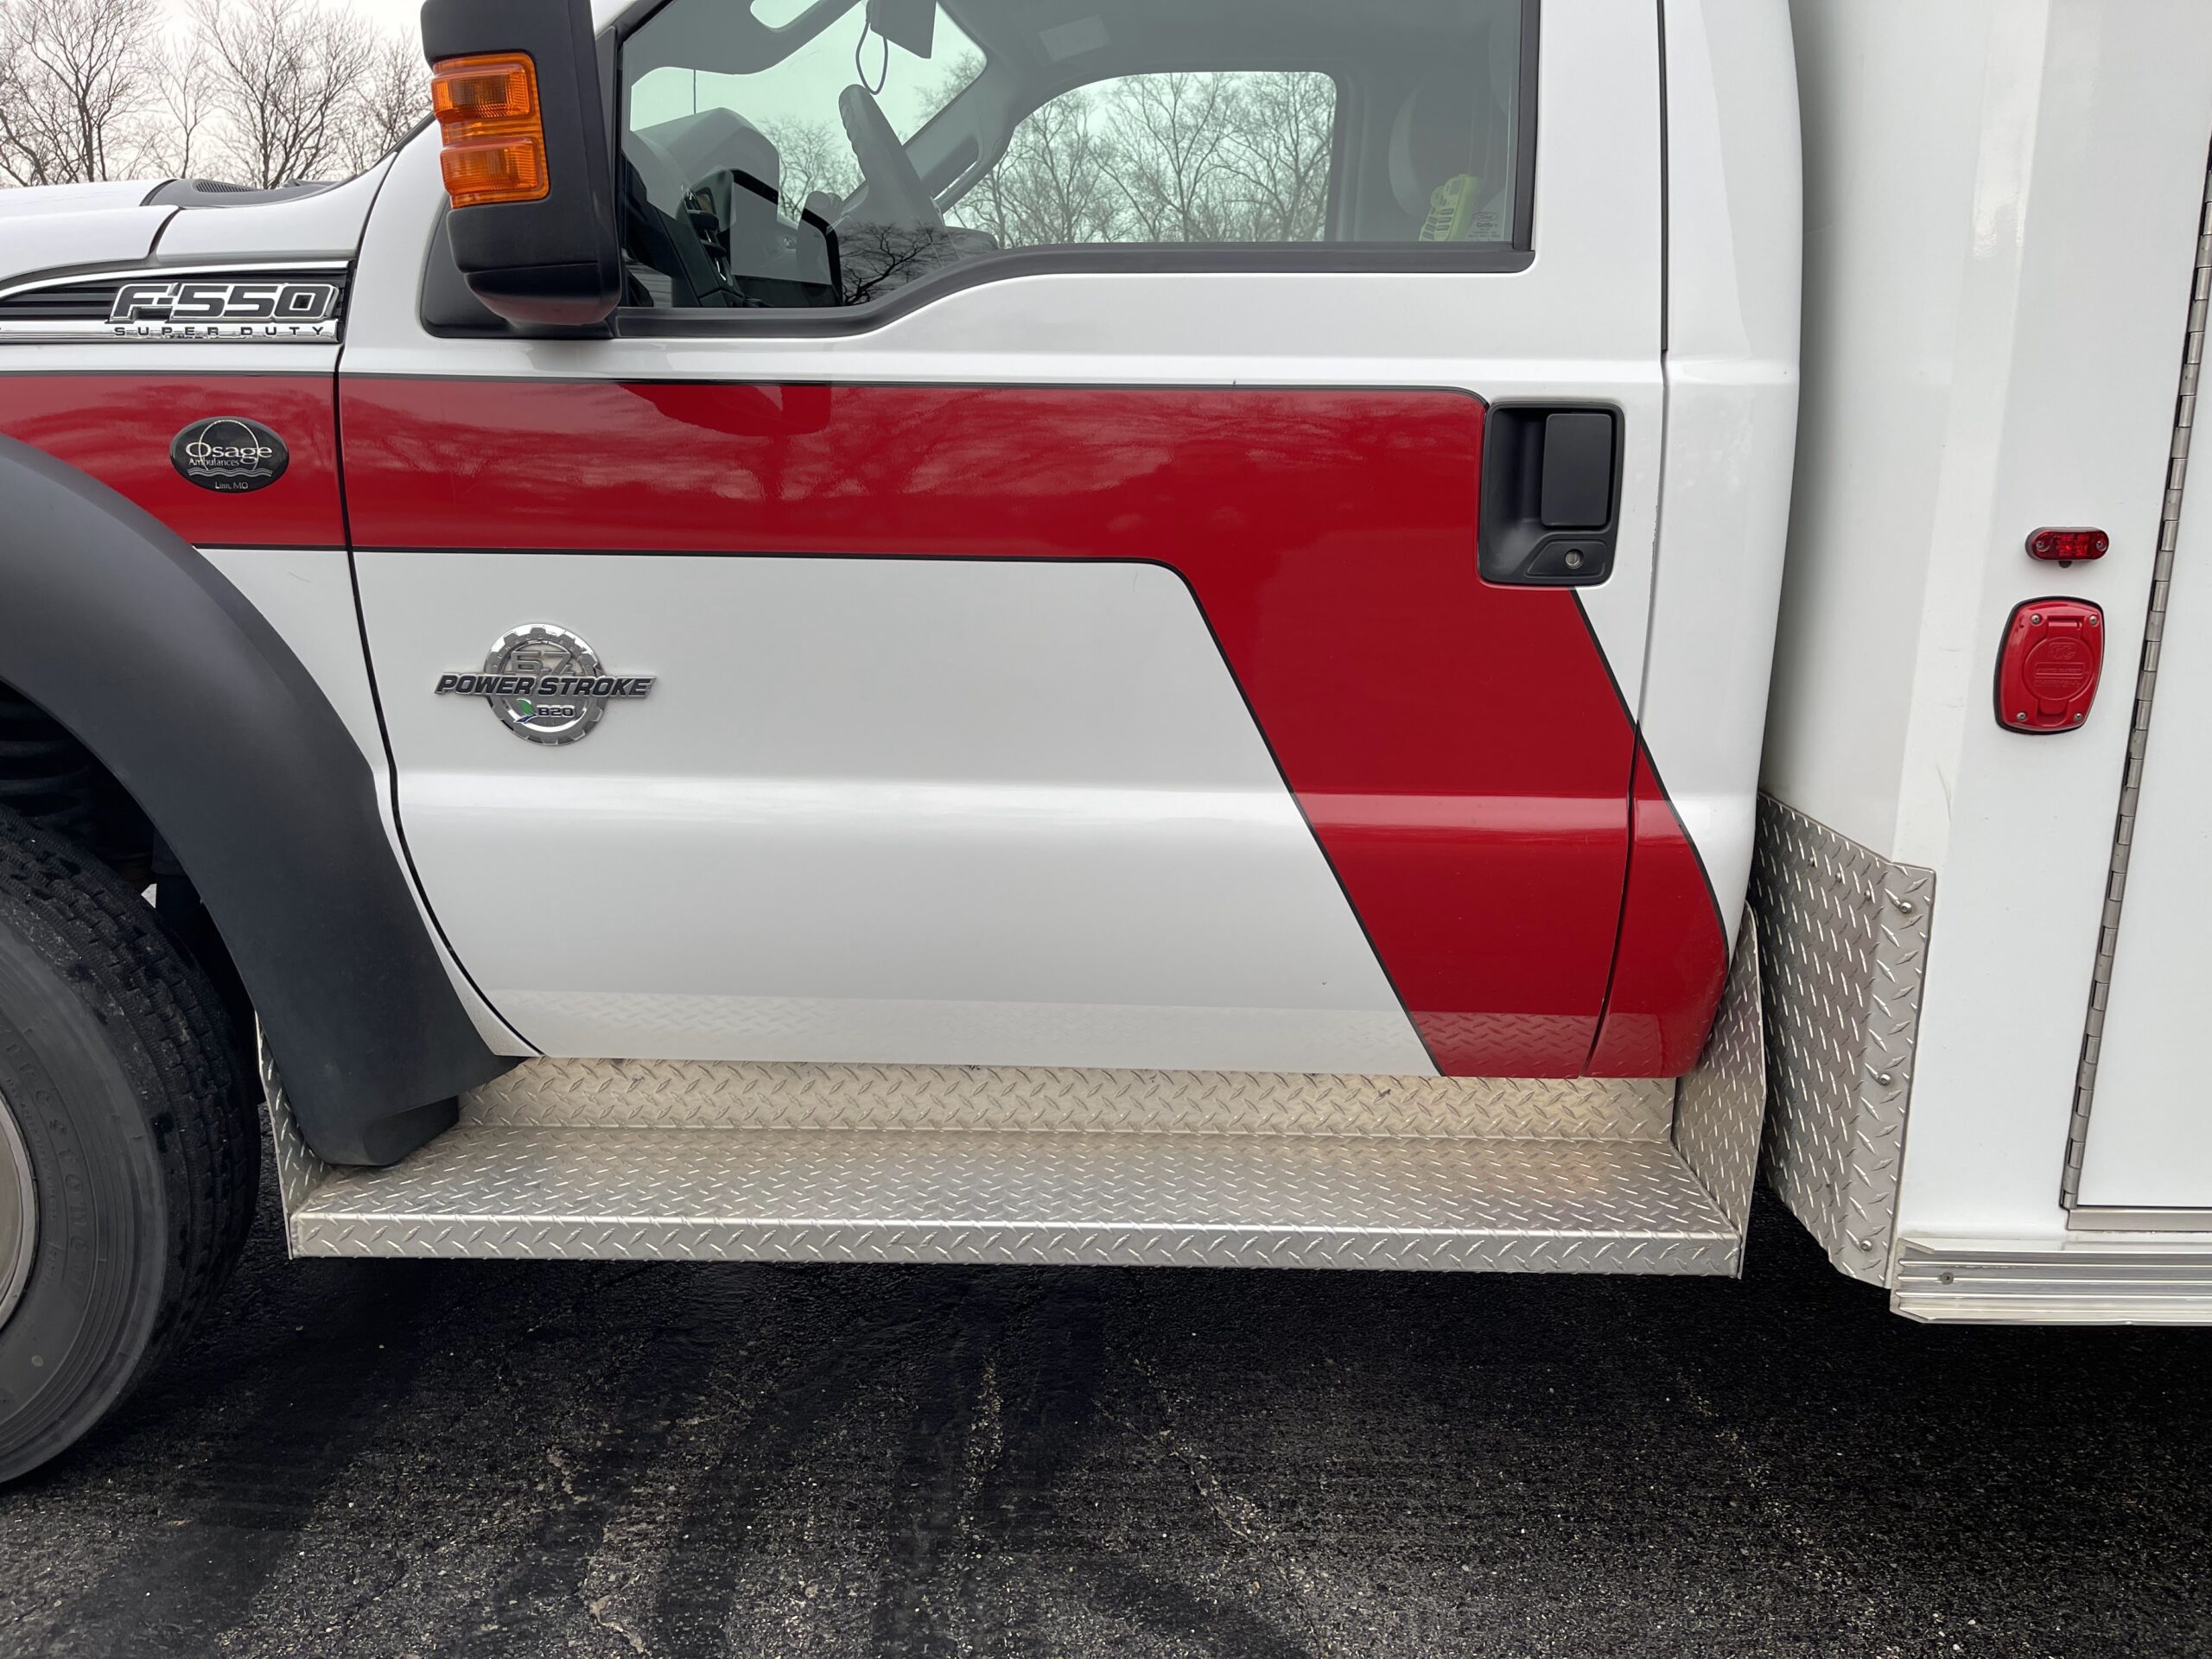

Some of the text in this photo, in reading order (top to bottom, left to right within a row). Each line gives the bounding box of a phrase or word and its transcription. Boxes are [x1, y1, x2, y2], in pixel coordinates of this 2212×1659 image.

[110, 283, 337, 322] F-550
[113, 327, 324, 336] SUPER DUTY
[186, 442, 273, 465] Osage
[188, 458, 240, 467] Ambulances
[435, 673, 656, 697] POWER STROKE
[537, 705, 575, 717] B20
